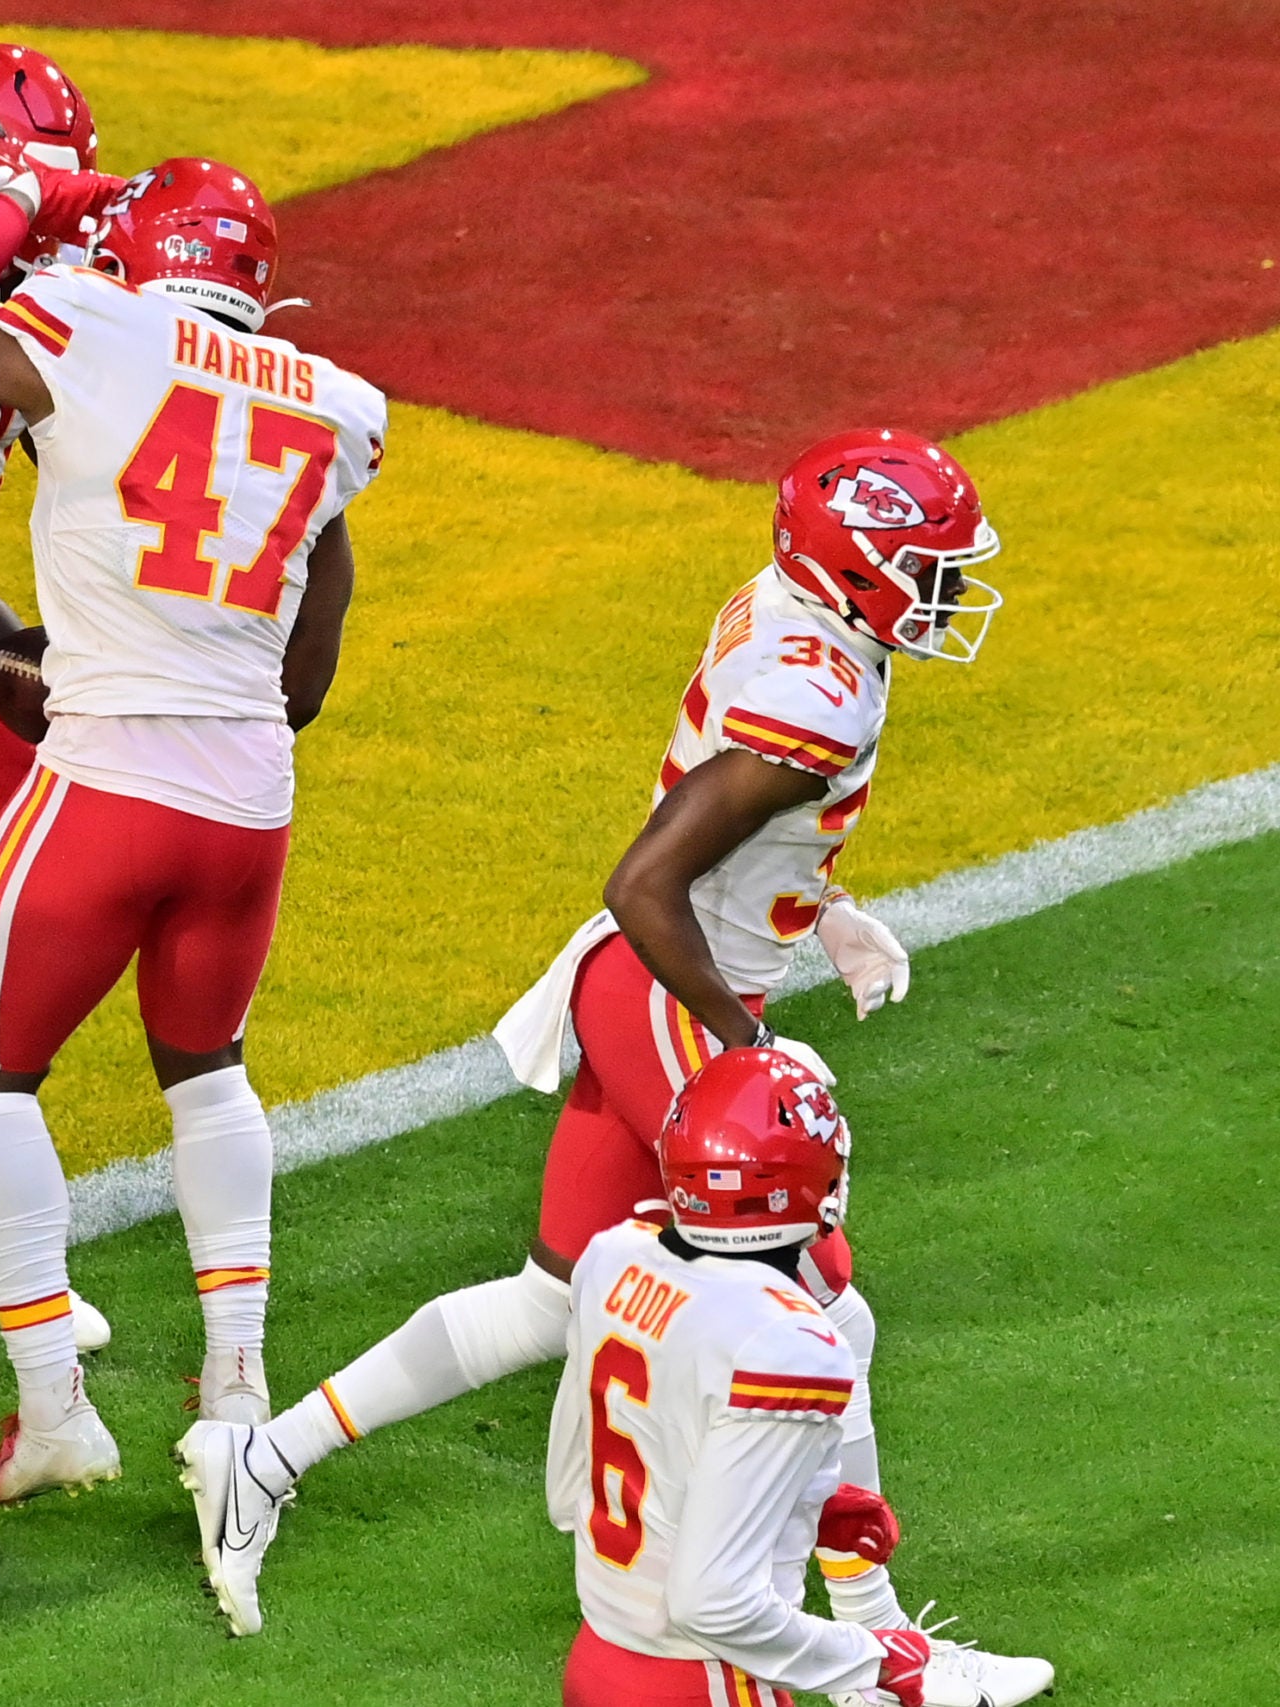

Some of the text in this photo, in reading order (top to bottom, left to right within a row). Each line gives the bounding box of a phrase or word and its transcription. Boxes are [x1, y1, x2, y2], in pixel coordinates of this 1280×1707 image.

[166, 284, 256, 315] BLACK LIVES MATTER
[175, 318, 315, 405] HARRIS
[114, 379, 338, 620] 47
[779, 634, 864, 698] 35
[689, 1231, 782, 1244] INSPIRE CHANGE
[604, 1264, 691, 1342] COOK
[587, 1332, 651, 1572] 6
